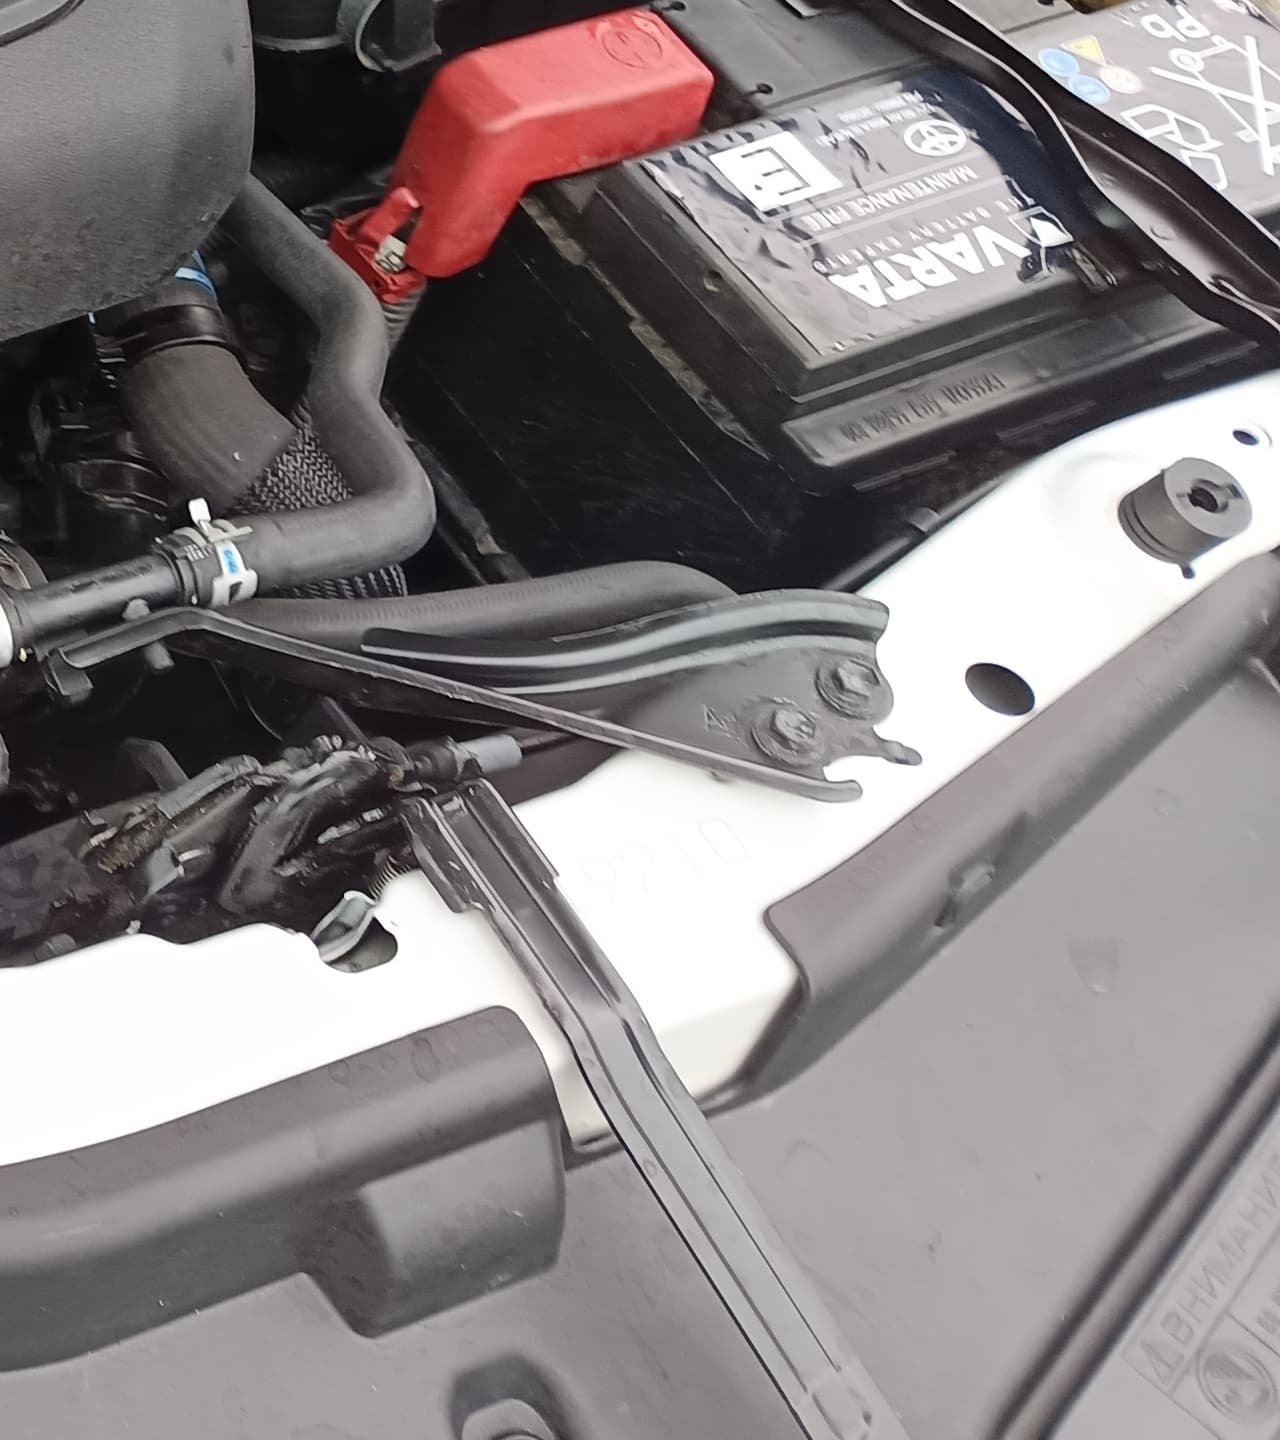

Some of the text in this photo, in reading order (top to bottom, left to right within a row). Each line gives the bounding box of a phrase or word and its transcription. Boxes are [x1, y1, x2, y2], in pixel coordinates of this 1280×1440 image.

[1141, 3, 1211, 43] Pb
[800, 165, 979, 233] MAINTENANCE FREE
[826, 224, 1033, 308] VARTA
